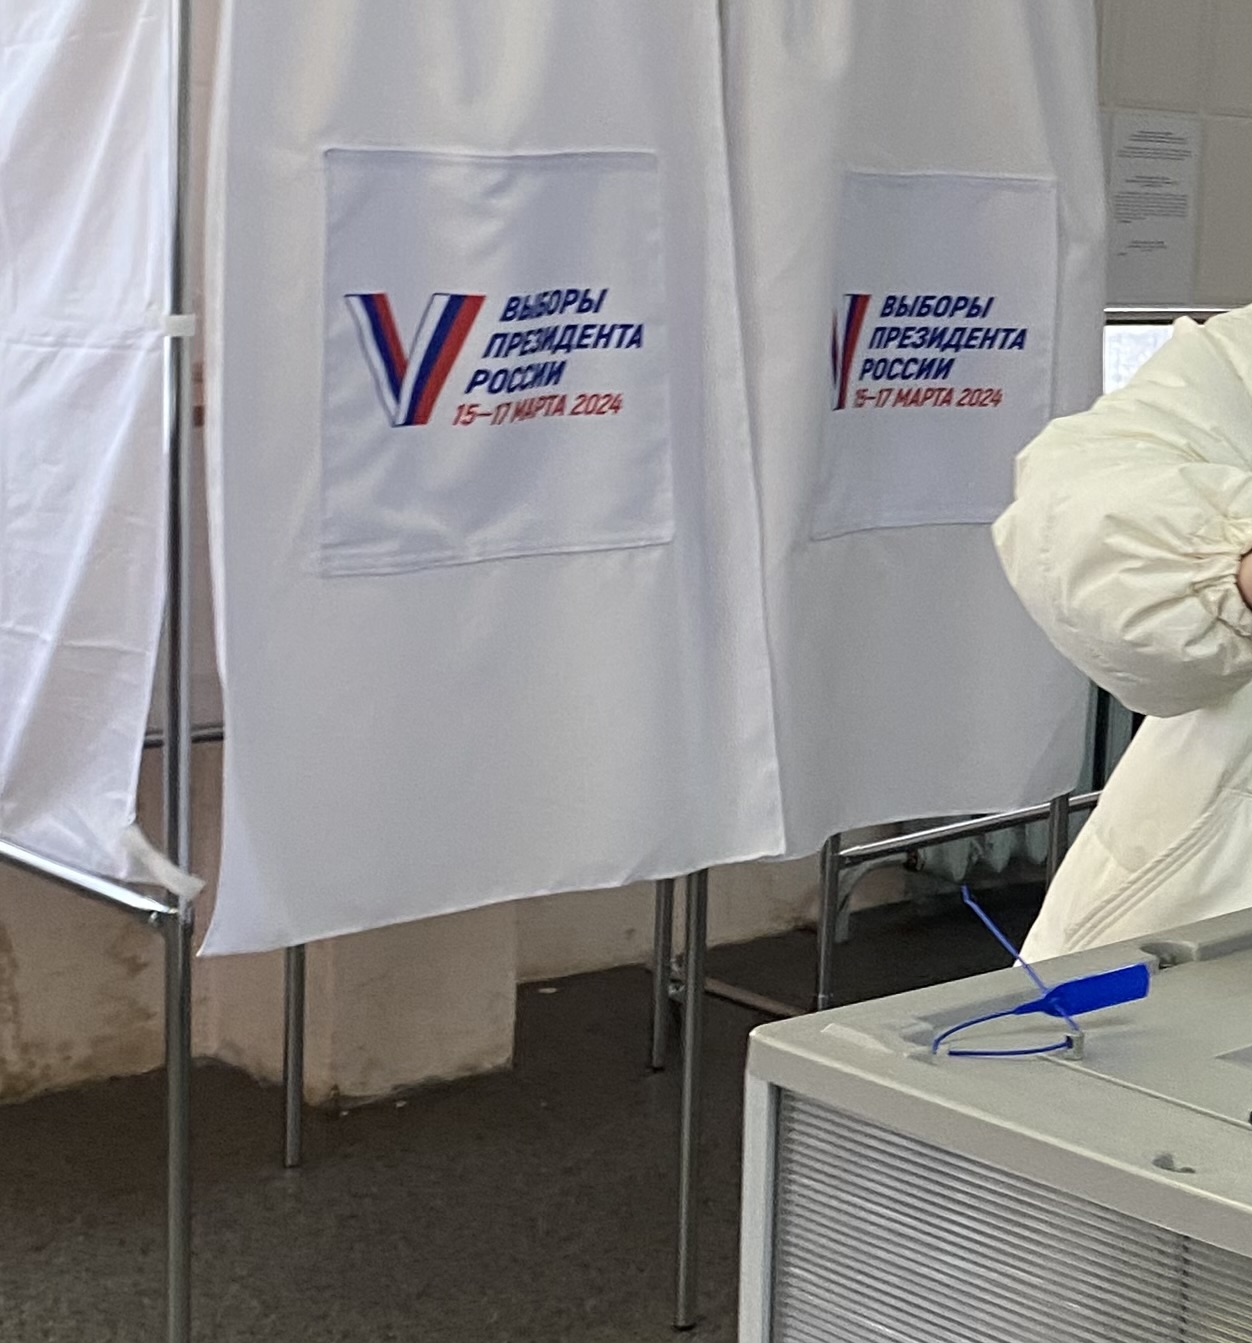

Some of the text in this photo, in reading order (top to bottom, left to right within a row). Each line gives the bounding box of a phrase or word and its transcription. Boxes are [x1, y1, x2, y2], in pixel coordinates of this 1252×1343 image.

[499, 288, 609, 322] ВЫБОРЫ
[880, 294, 995, 319] ВЫБОРЫ
[481, 323, 645, 359] ПРЕЗИДЕНТА
[868, 326, 1028, 353] ПРЕЗИДЕНТА
[464, 360, 568, 395] РОССИИ
[858, 358, 956, 381] РОССИИ
[511, 394, 568, 424] МАРТА
[569, 392, 623, 416] 2024
[892, 387, 954, 408] МАРТА
[956, 387, 1003, 407] 2024
